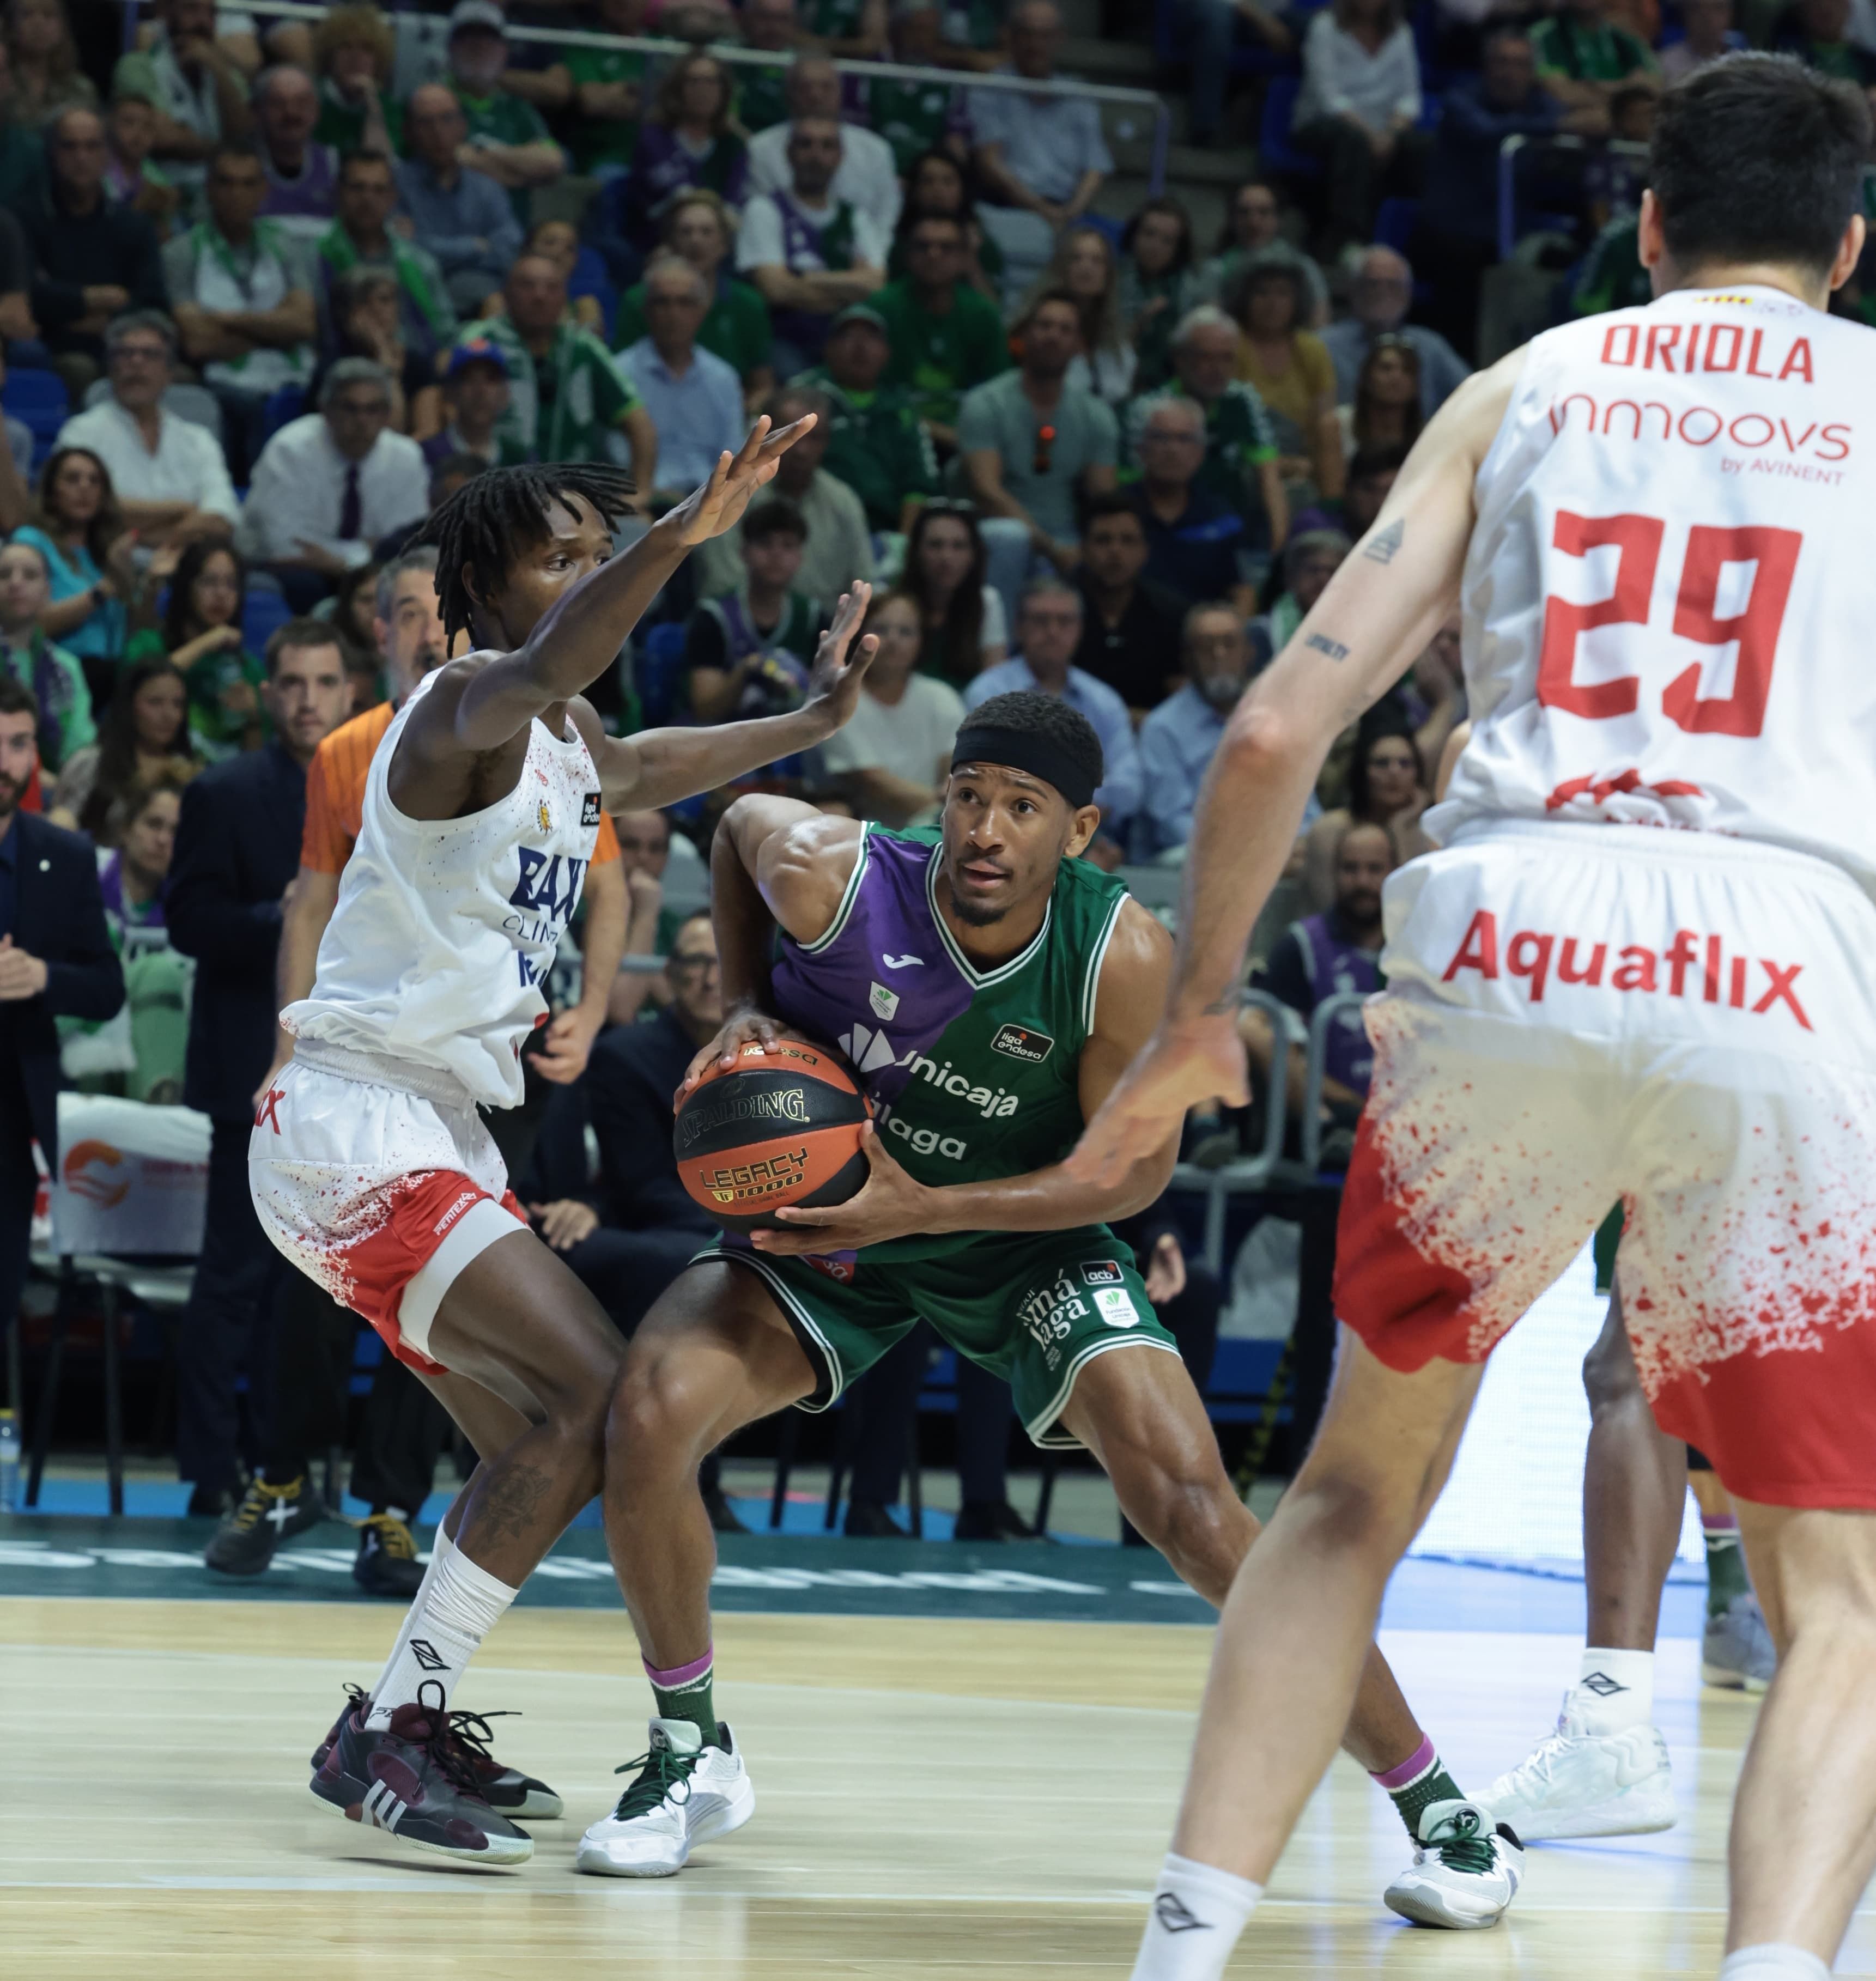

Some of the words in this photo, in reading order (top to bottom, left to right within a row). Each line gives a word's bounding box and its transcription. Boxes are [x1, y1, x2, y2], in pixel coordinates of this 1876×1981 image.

[1601, 324, 1814, 384] ORIOLA
[1720, 457, 1744, 475] by
[1750, 459, 1845, 486] AVINENT
[1537, 508, 1803, 739] 29
[998, 1041, 1042, 1059] endesa
[1001, 1032, 1023, 1045] liga
[894, 1050, 1019, 1119] Unicaja
[682, 1089, 804, 1148] SPALDING
[700, 1146, 809, 1189] LEGACY
[735, 1172, 804, 1199] 1000
[1088, 1269, 1114, 1281] acb
